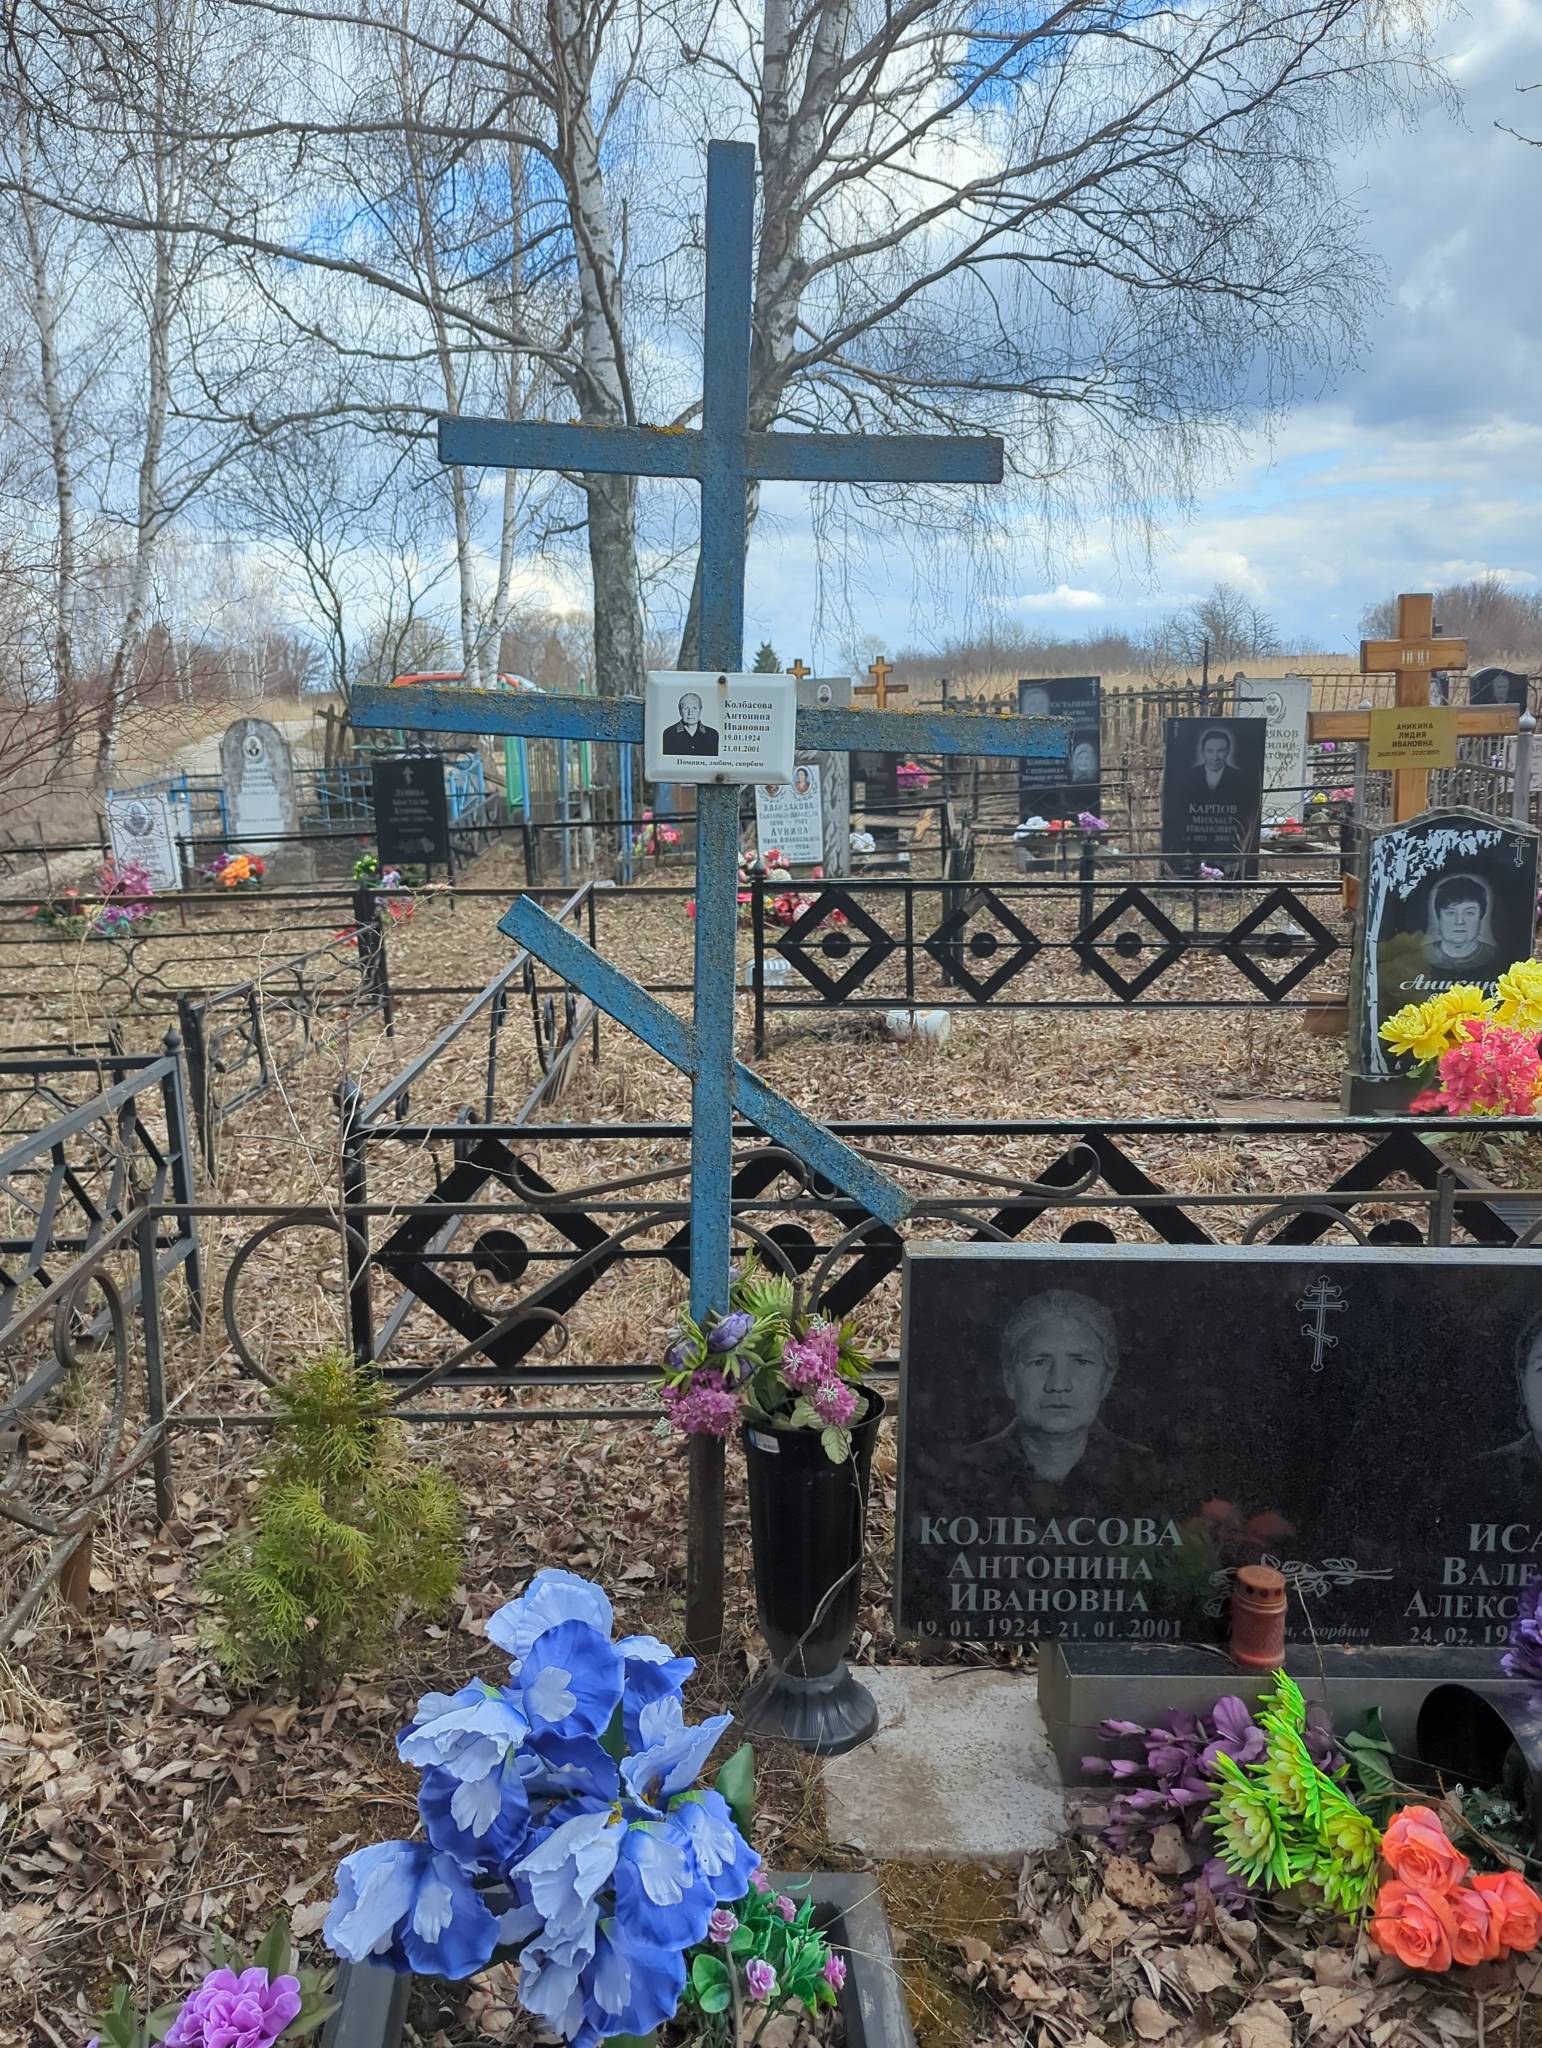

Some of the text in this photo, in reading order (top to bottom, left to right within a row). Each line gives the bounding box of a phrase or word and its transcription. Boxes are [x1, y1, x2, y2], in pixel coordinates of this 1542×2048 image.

[724, 700, 773, 710] Колбасова
[724, 712, 771, 721] Антонина
[724, 722, 770, 731] Ивановна
[1396, 722, 1434, 730] АНИКИНА
[724, 734, 761, 742] 19.01.1924
[1398, 731, 1427, 739] ЛИДИЯ
[1392, 739, 1433, 748] ИВАНОВНА
[722, 745, 760, 753] 21.01.2001
[1189, 803, 1237, 814] КАРПОВ
[918, 1516, 1185, 1547] КОЛБАСОВА
